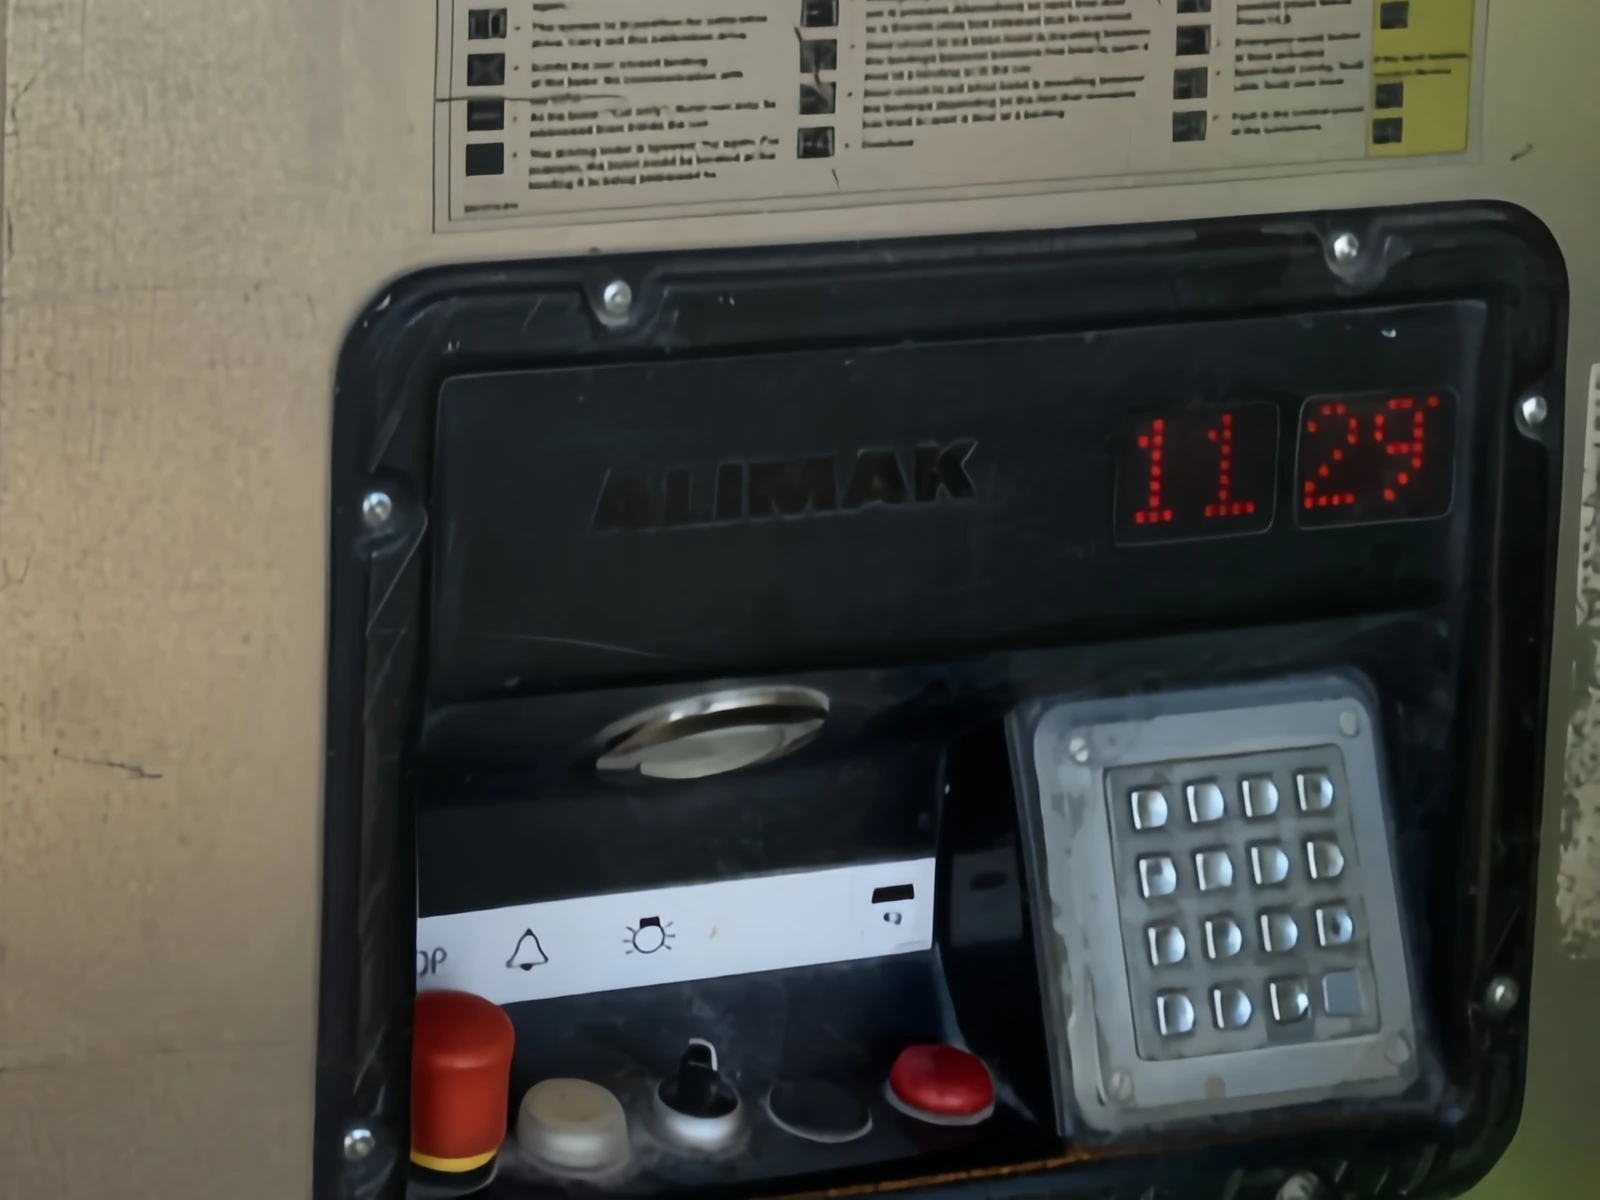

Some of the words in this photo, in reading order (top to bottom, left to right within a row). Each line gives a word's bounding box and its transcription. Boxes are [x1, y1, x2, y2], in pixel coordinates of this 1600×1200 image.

[586, 438, 982, 534] ALIMAK
[1303, 396, 1437, 510] 29
[416, 945, 448, 978] OP
